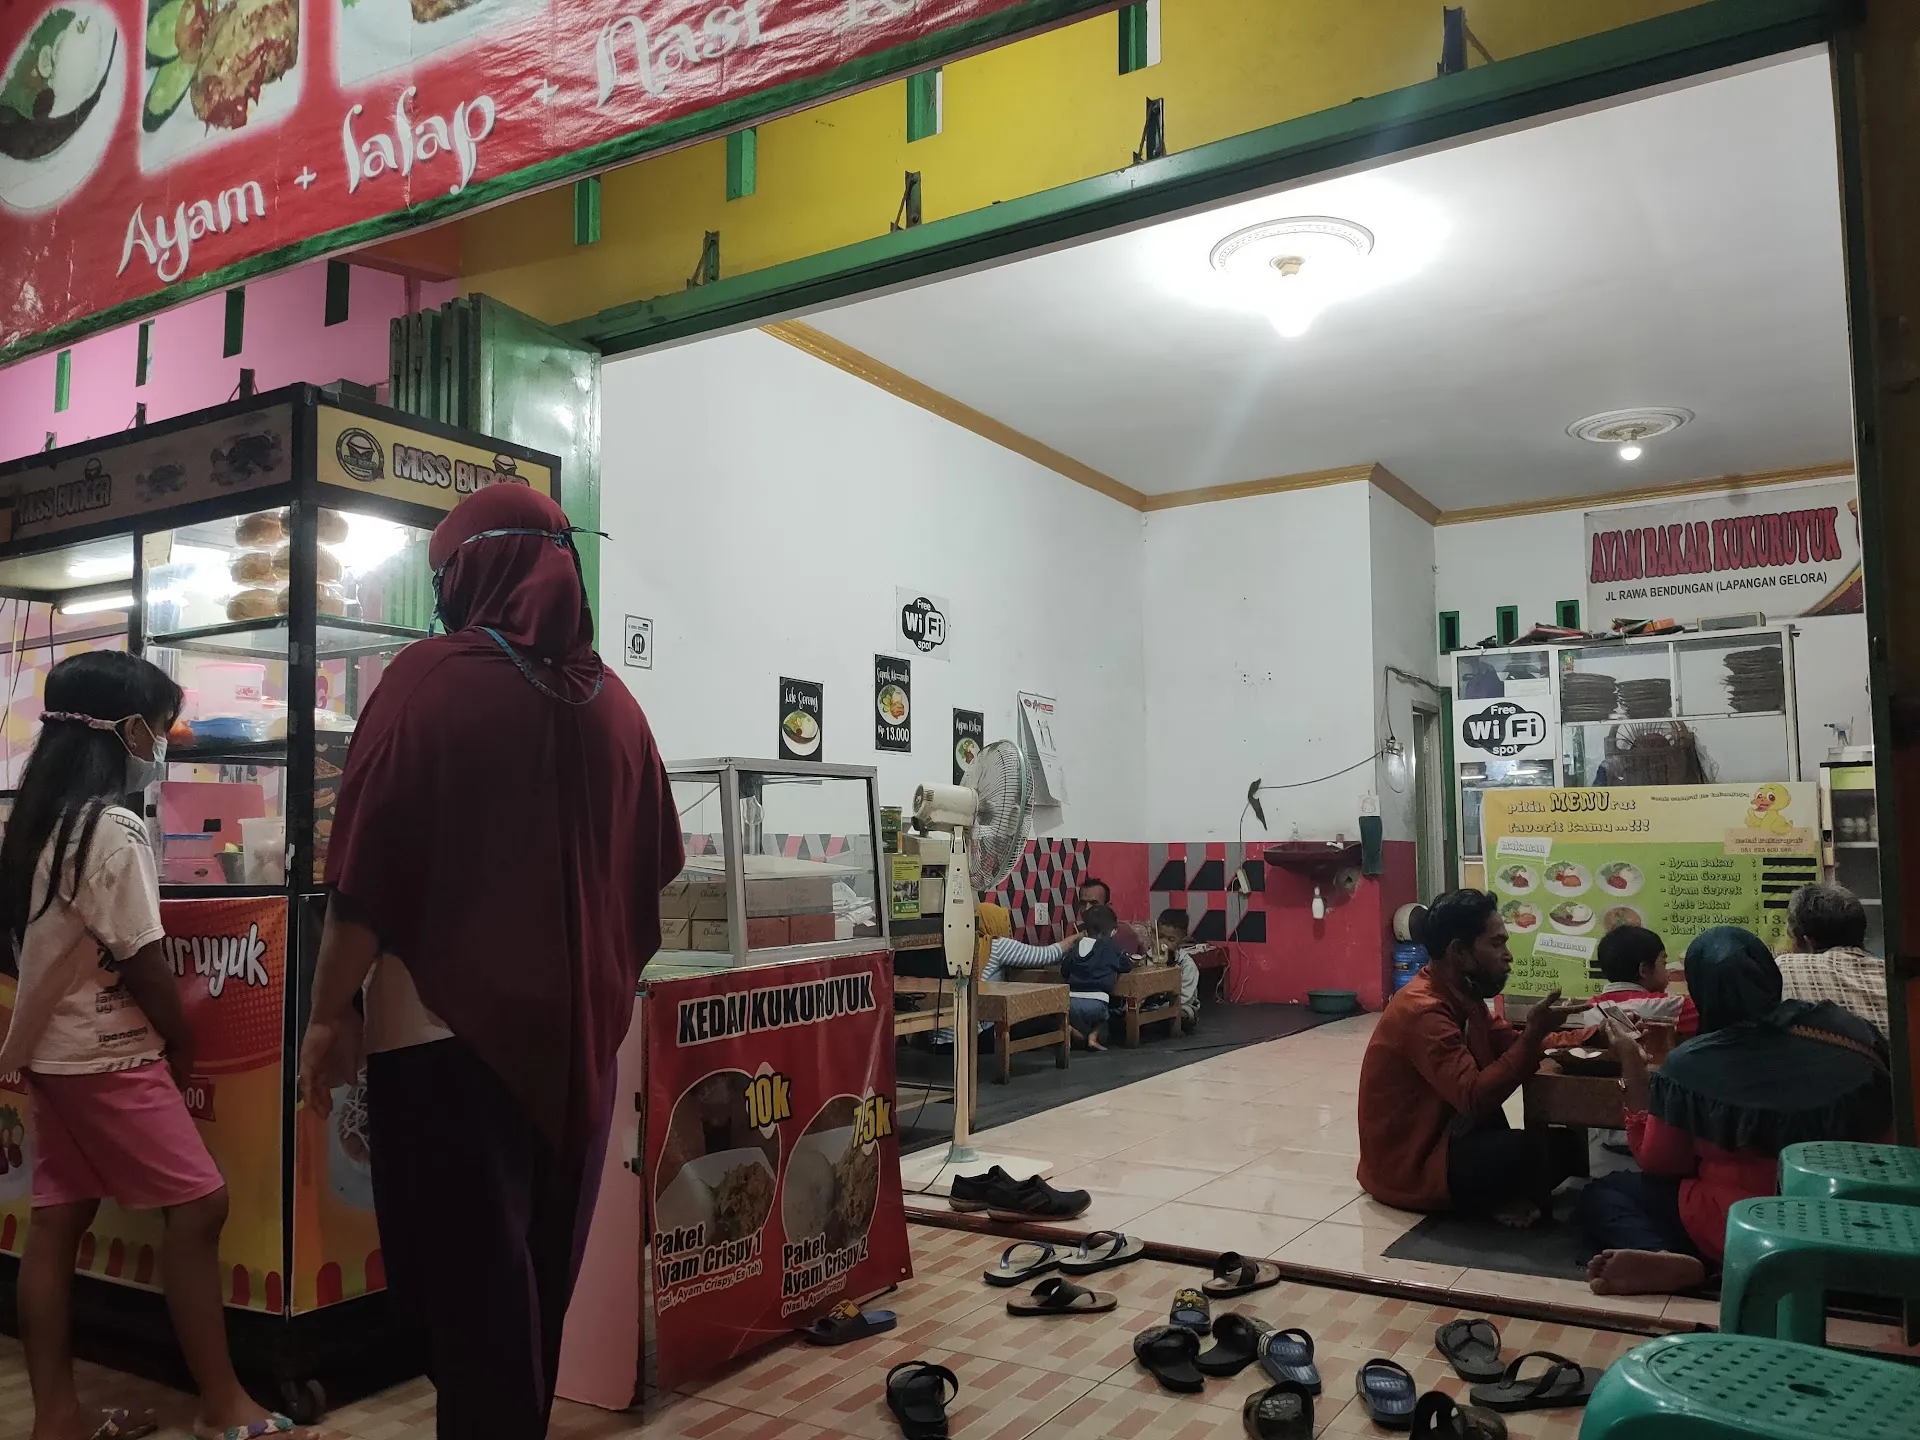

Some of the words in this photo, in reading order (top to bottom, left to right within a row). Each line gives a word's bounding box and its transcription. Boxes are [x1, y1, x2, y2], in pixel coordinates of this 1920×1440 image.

[116, 180, 265, 282] Ayam
[343, 86, 495, 194] lalap
[393, 443, 451, 489] MISS
[1591, 528, 1643, 583] AYAM
[1643, 521, 1712, 578] BAKAR
[1711, 506, 1842, 571] KUKURUYUK
[1605, 591, 1617, 602] JL
[1619, 588, 1648, 600] RAWA
[1650, 582, 1714, 598] BENDUNGAN
[1716, 576, 1776, 594] (LAPANGAN
[1779, 571, 1828, 586] GELORA)
[917, 600, 931, 611] Free
[917, 640, 932, 650] spot
[798, 691, 819, 713] Goreng
[1490, 705, 1516, 715] Free
[886, 726, 910, 742] 13.000
[1492, 744, 1519, 756] spot
[1507, 800, 1546, 814] pilih
[1508, 821, 1563, 833] favorit
[1763, 915, 1786, 925] 13.
[678, 992, 747, 1044] KEDAI
[751, 974, 874, 1030] KUKURUYUK
[745, 1075, 791, 1128] 10k
[655, 1224, 705, 1261] Paket
[703, 1237, 752, 1274] Crispy
[783, 1234, 825, 1268] Paket
[783, 1263, 823, 1296] Ayam
[824, 1243, 860, 1279] Crispy
[859, 1236, 867, 1259] 2
[677, 1285, 702, 1301] Ayam
[705, 1276, 734, 1290] Crispy,
[736, 1269, 746, 1281] Es
